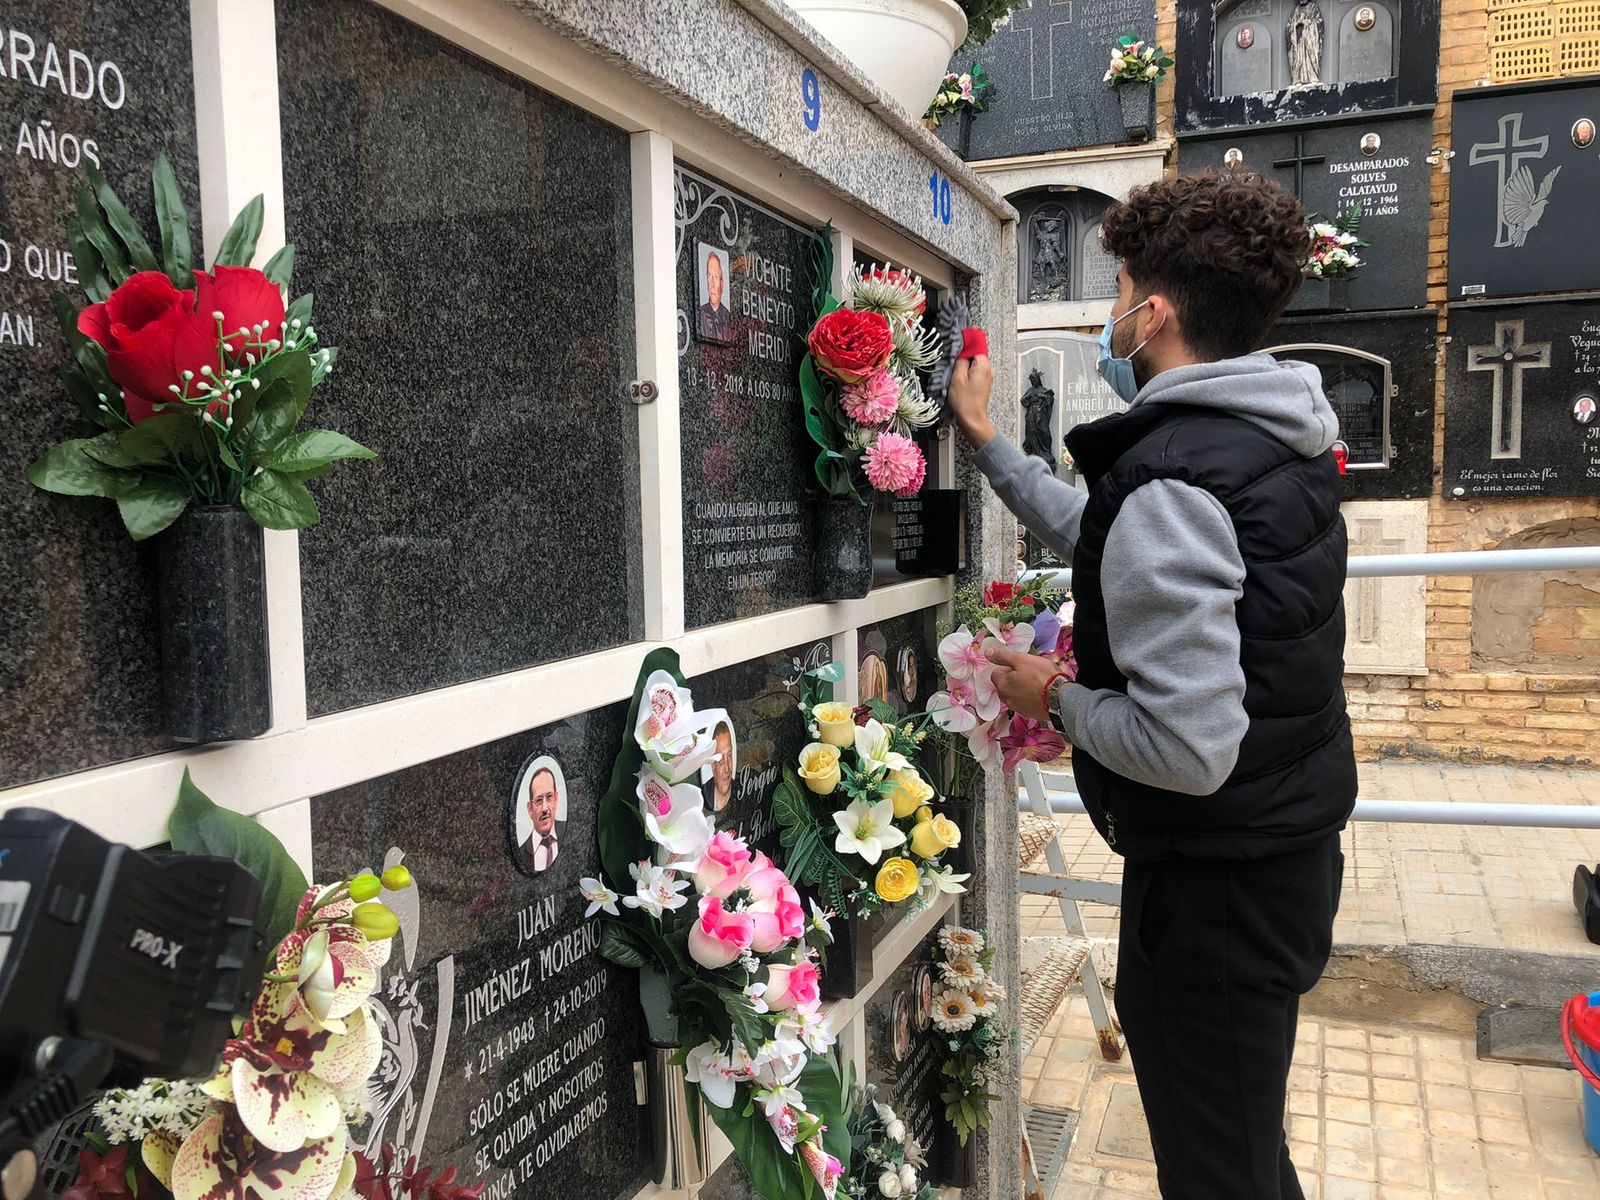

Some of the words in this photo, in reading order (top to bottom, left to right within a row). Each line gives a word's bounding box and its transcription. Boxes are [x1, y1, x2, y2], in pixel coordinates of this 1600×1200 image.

[0, 28, 126, 110] RADO
[801, 67, 821, 132] 9
[15, 119, 101, 170] AÑOS
[1329, 156, 1410, 175] DESAMPARADOS
[1350, 171, 1387, 184] SOLVES
[919, 170, 951, 226] 10
[1339, 183, 1398, 197] CALATAYUD
[1380, 195, 1399, 205] 1964
[1375, 205, 1399, 216] AÑOS
[24, 244, 80, 284] QUE
[743, 250, 793, 294] VICENTE
[742, 288, 796, 330] BENEYTO
[748, 328, 792, 364] MERIDA
[724, 373, 744, 395] 2018
[755, 379, 771, 399] LOS
[1065, 397, 1104, 412] ANDREU
[1067, 380, 1115, 396] ENCARN
[1460, 469, 1473, 480] El
[1473, 471, 1498, 483] mejor
[1502, 471, 1528, 479] ramo
[1529, 470, 1540, 479] de
[1541, 467, 1558, 482] flor
[695, 503, 728, 519] CUANDO
[728, 502, 758, 518] ALGUIEN
[758, 501, 767, 516] AL
[767, 501, 781, 516] QUE
[781, 500, 798, 516] AMAS
[691, 529, 702, 545] SE
[703, 526, 745, 545] CONVIERTE
[746, 525, 756, 541] EN
[757, 524, 767, 540] UN
[704, 552, 714, 569] LA
[715, 550, 749, 568] MEMORIA
[749, 548, 759, 564] SE
[759, 544, 794, 562] CONVIERTE
[728, 575, 738, 591] EN
[750, 569, 777, 587] TESORO
[737, 761, 779, 804] Sergio
[517, 894, 556, 950] JUAN
[130, 928, 183, 969] PRO-X
[464, 957, 532, 1035] JIMÉNEZ
[539, 917, 602, 982] MORENO
[469, 1090, 504, 1136] SÓLO
[506, 1077, 521, 1109] SE
[523, 1048, 561, 1096] MUERE
[563, 1016, 605, 1065] CUANDO
[474, 1144, 491, 1177] SE
[493, 1109, 537, 1162] OLVIDA
[538, 1100, 547, 1124] Y
[548, 1055, 604, 1118] NOSOTROS
[518, 1152, 534, 1183] TE
[535, 1090, 608, 1169] OLVIDAREMOS
